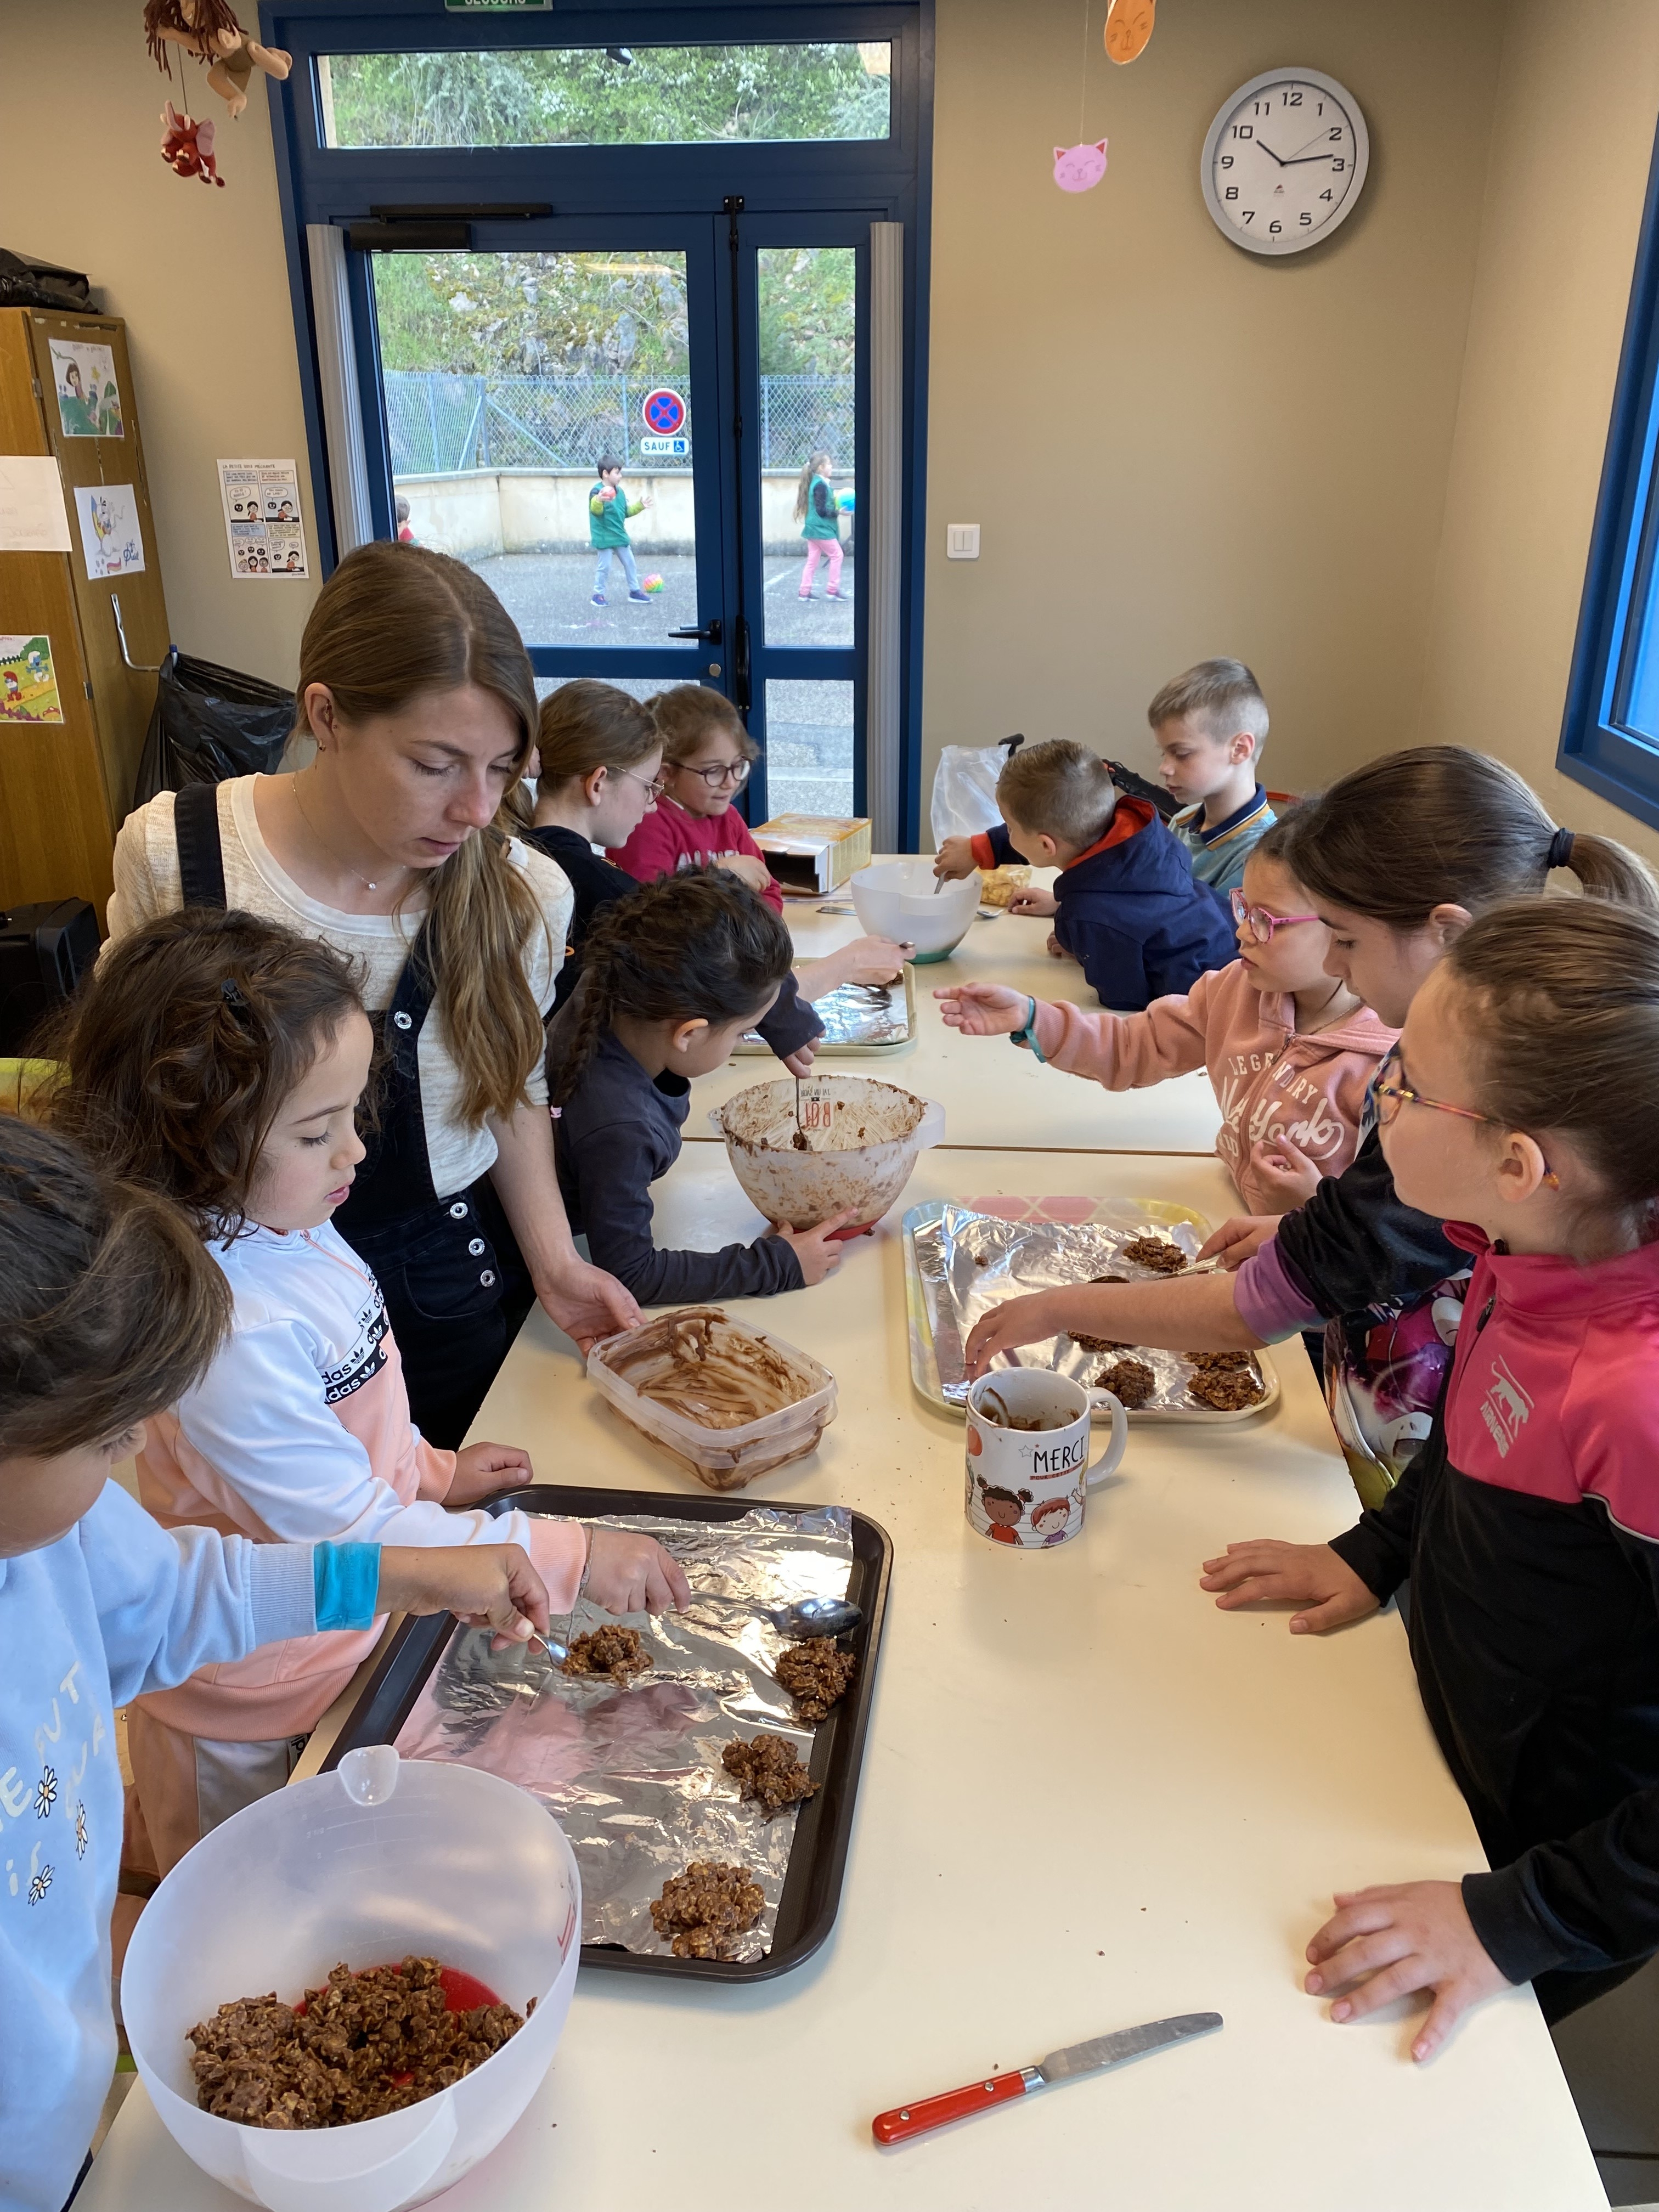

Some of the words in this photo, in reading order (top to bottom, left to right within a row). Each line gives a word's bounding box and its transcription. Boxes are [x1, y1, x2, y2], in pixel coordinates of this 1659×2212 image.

[1282, 92, 1303, 106] 12
[1254, 101, 1271, 115] 11
[1317, 103, 1323, 116] 1
[1232, 125, 1254, 139] 10
[1329, 127, 1342, 141] 2
[1221, 156, 1234, 169] 9
[1332, 158, 1345, 171] 3
[1225, 187, 1239, 200] 8
[1319, 188, 1333, 202] 4
[1242, 211, 1255, 225] 7
[1299, 212, 1312, 225] 5
[1269, 220, 1282, 234] 6
[644, 441, 670, 451] SAUF
[1034, 1435, 1085, 1473] MERCI
